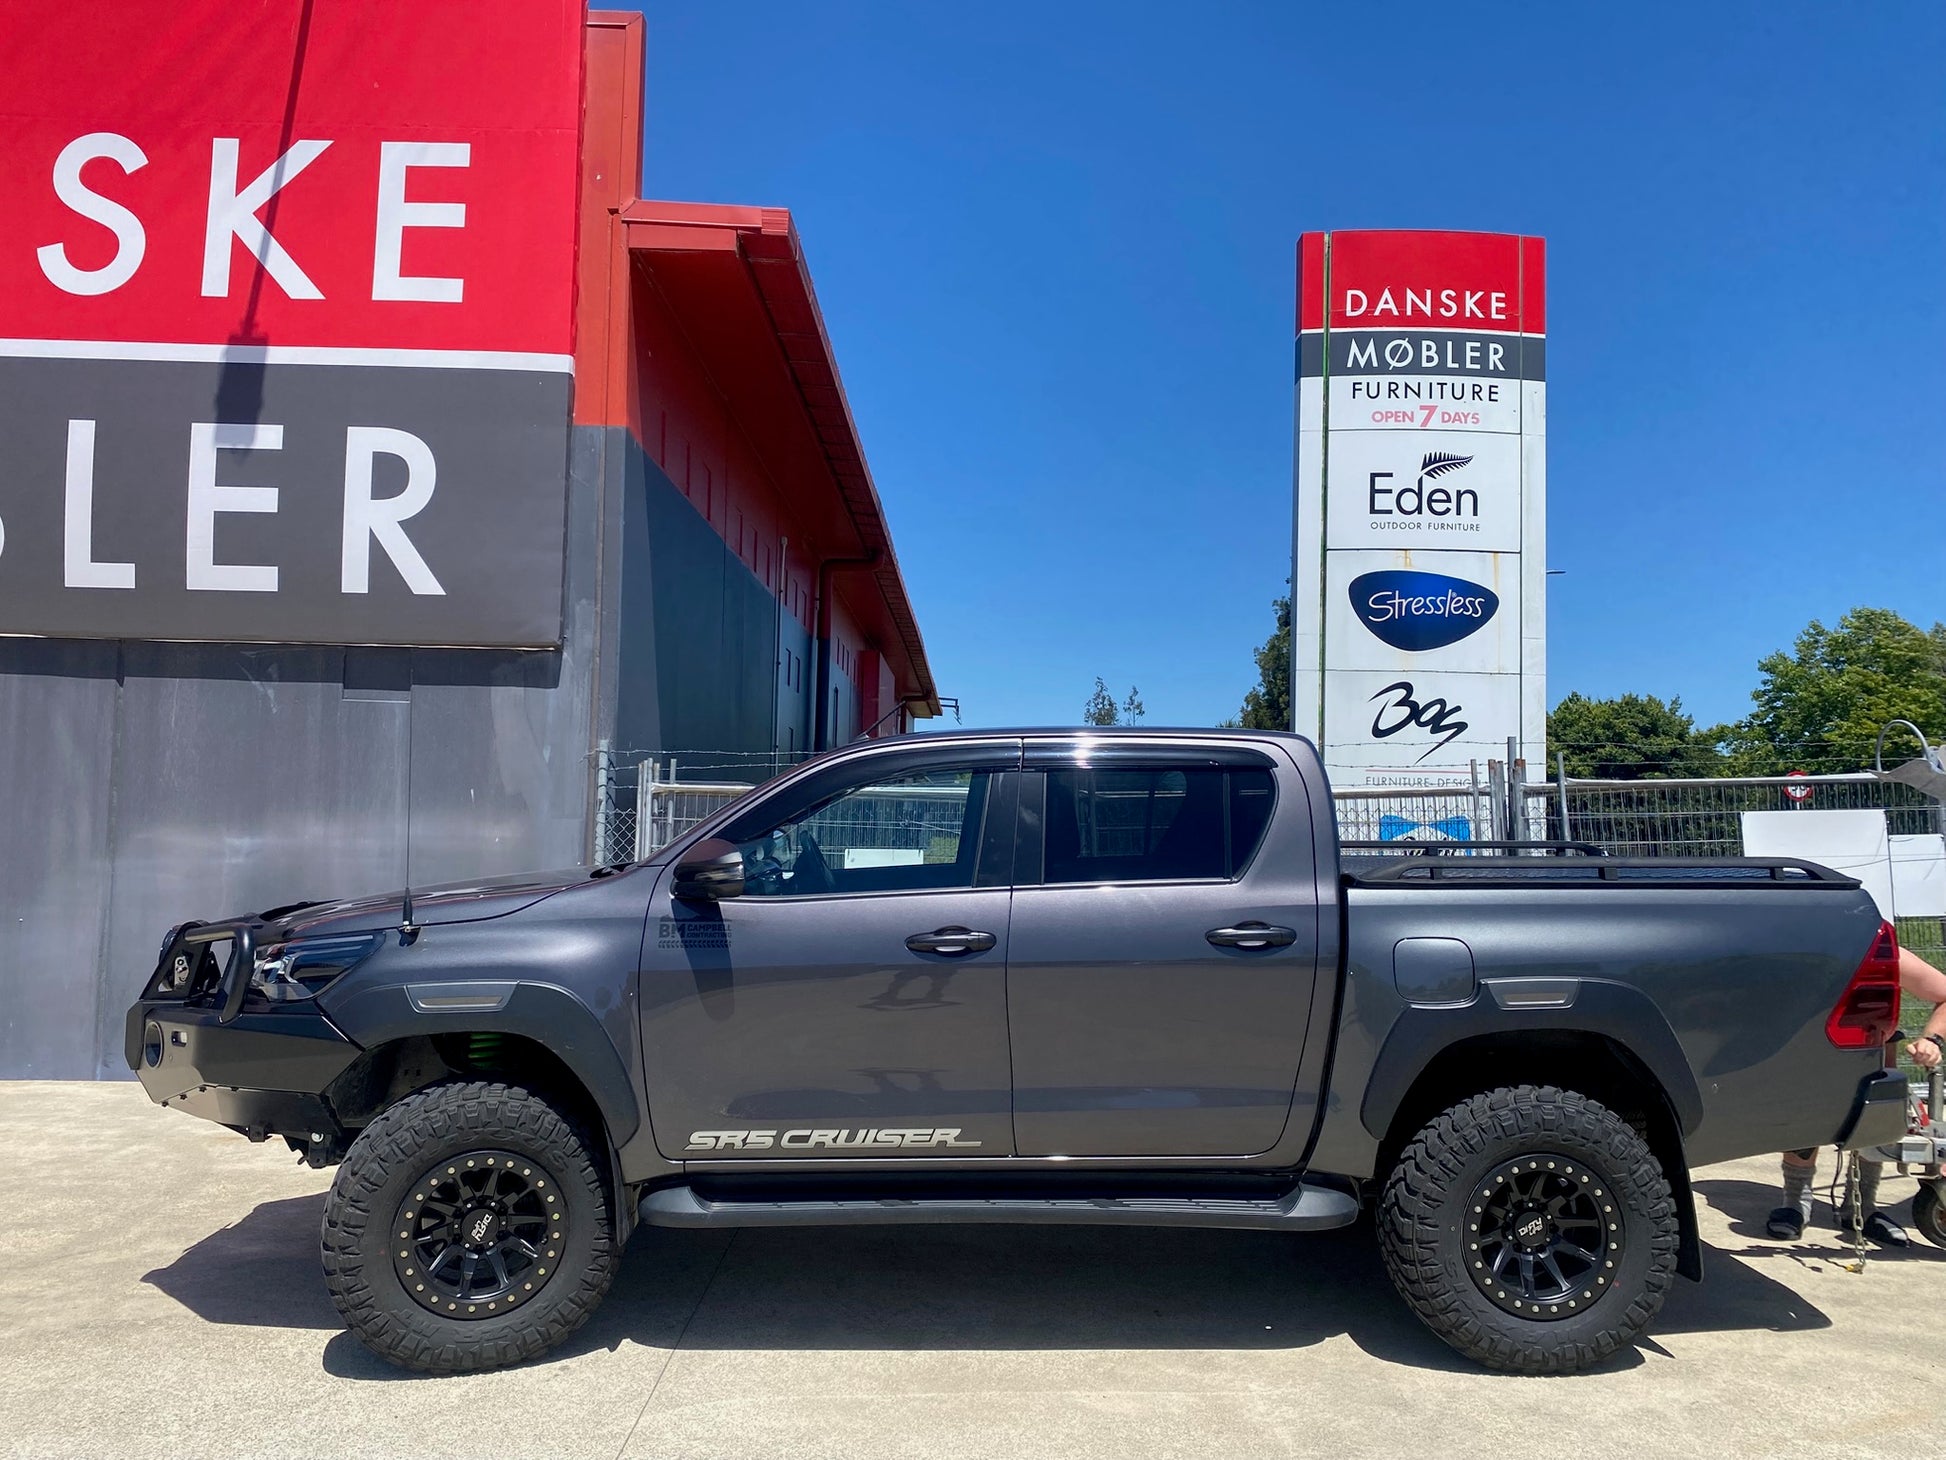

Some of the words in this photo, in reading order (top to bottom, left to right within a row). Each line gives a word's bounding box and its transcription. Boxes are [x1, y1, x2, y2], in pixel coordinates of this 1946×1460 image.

[37, 132, 471, 303] SKE
[1345, 286, 1507, 320] DANSKE
[1346, 338, 1506, 371] MØBLER
[1351, 381, 1499, 402] FURNITURE
[1371, 411, 1414, 423] OPEN
[1419, 405, 1438, 428] 7
[1441, 411, 1480, 424] DAYS
[1369, 472, 1478, 517] Eden
[0, 419, 446, 596] LER
[1370, 521, 1422, 531] OUTDOOR
[1427, 522, 1481, 532] FURNITURE
[1368, 589, 1485, 622] Stressless
[1365, 776, 1430, 787] FURNITURE
[1437, 778, 1481, 788] DESIG
[687, 923, 731, 932] CAMPBELL
[780, 1128, 982, 1149] CRUISER
[1518, 1217, 1542, 1236] DIRTY
